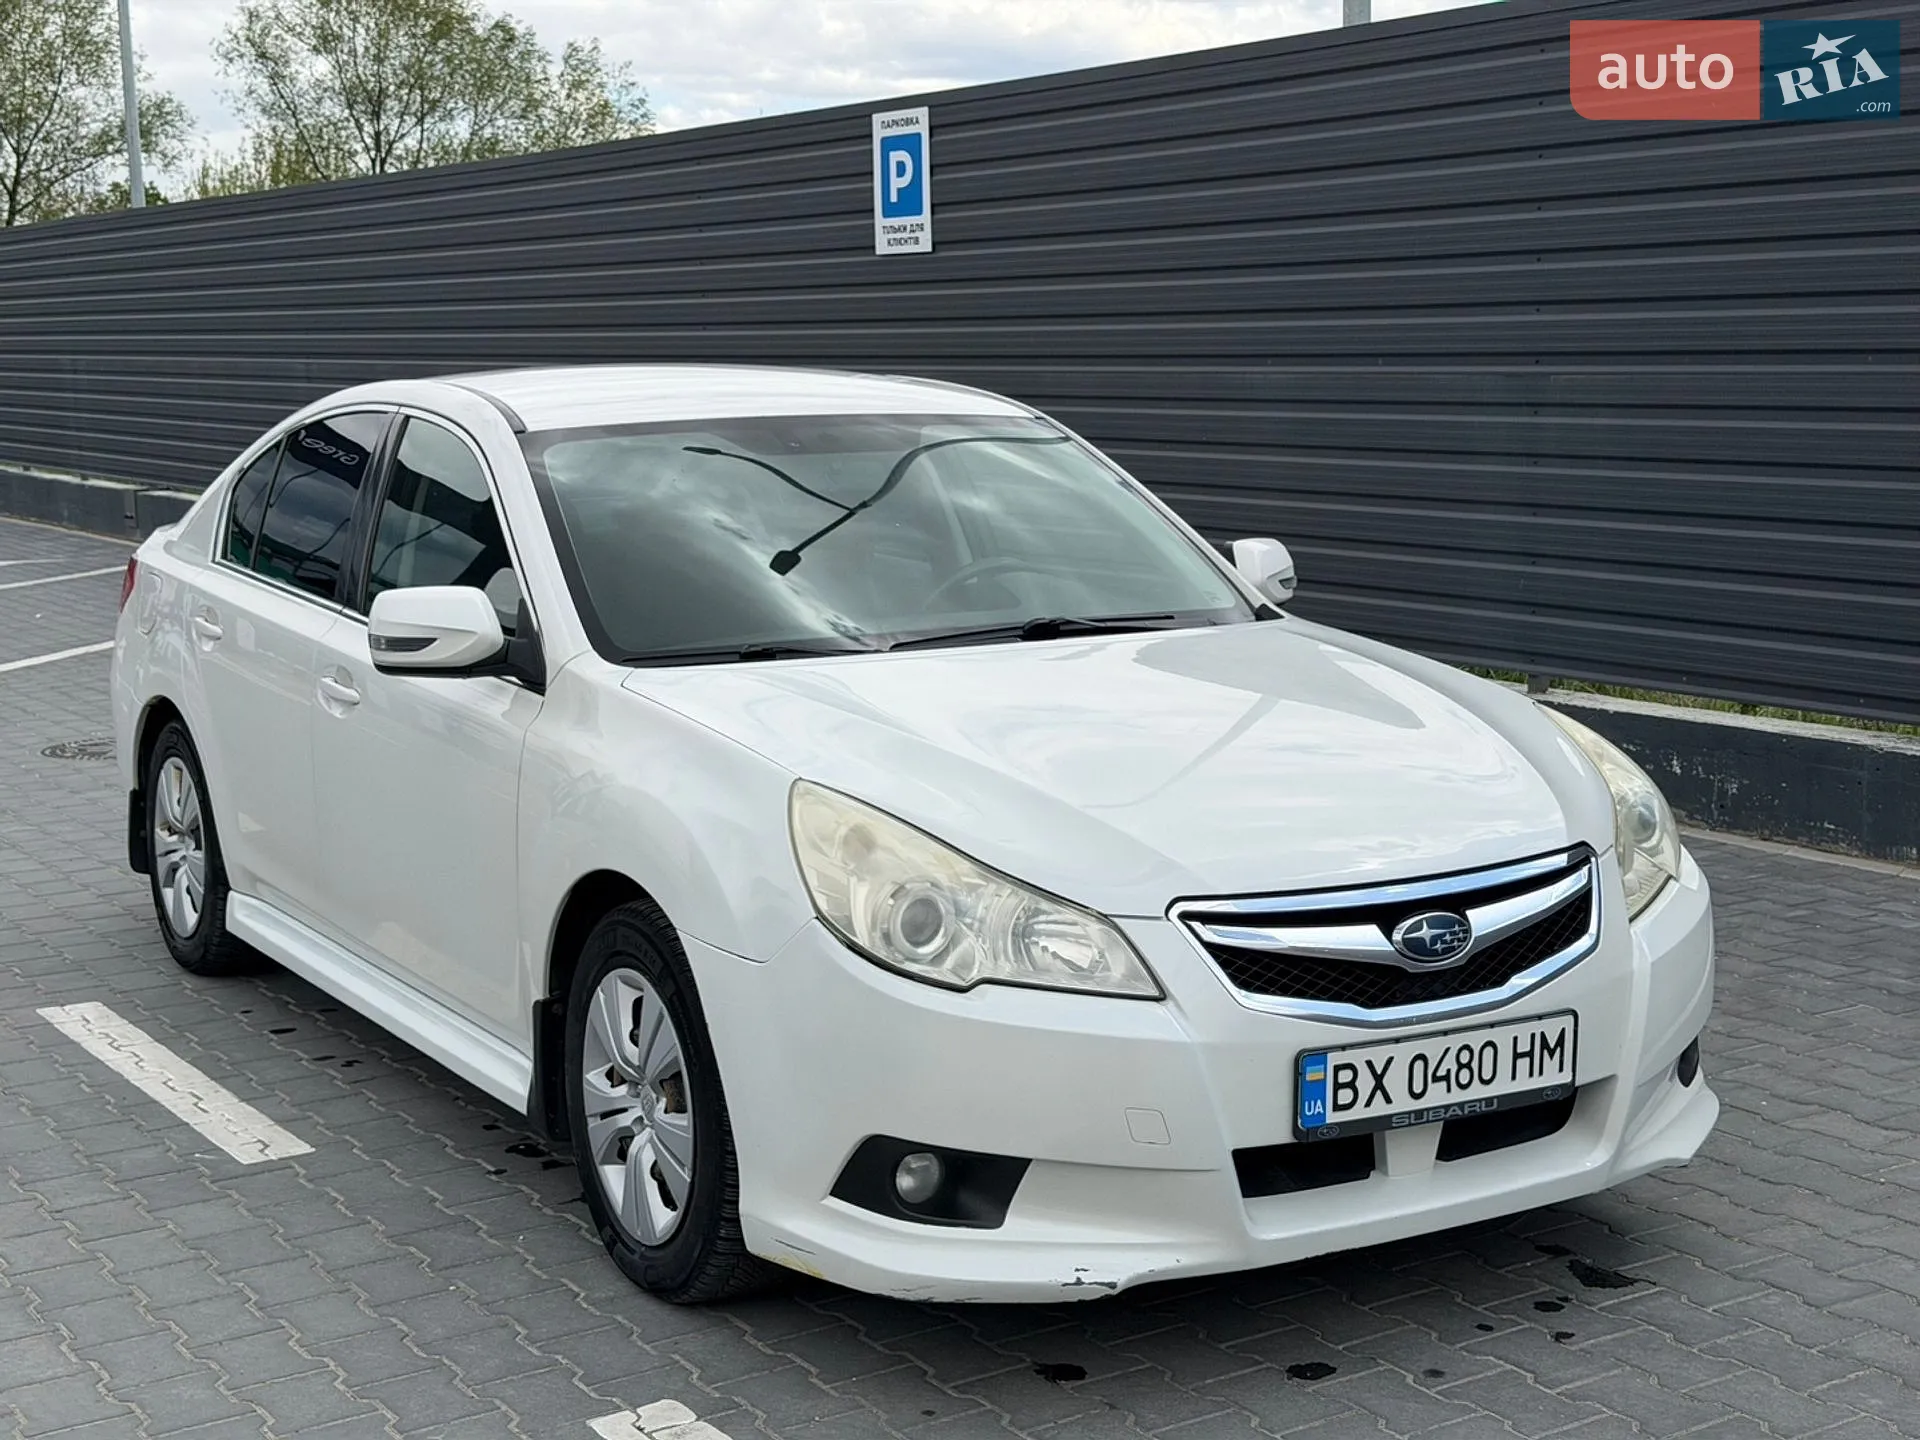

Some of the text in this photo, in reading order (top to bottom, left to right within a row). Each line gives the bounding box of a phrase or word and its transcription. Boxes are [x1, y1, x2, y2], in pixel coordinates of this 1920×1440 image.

[881, 116, 920, 130] ПАРКОВКА
[889, 150, 914, 203] P
[1332, 1027, 1566, 1112] BX 0480 HM
[1304, 1100, 1324, 1116] UA
[1391, 1099, 1498, 1128] SUBARU
